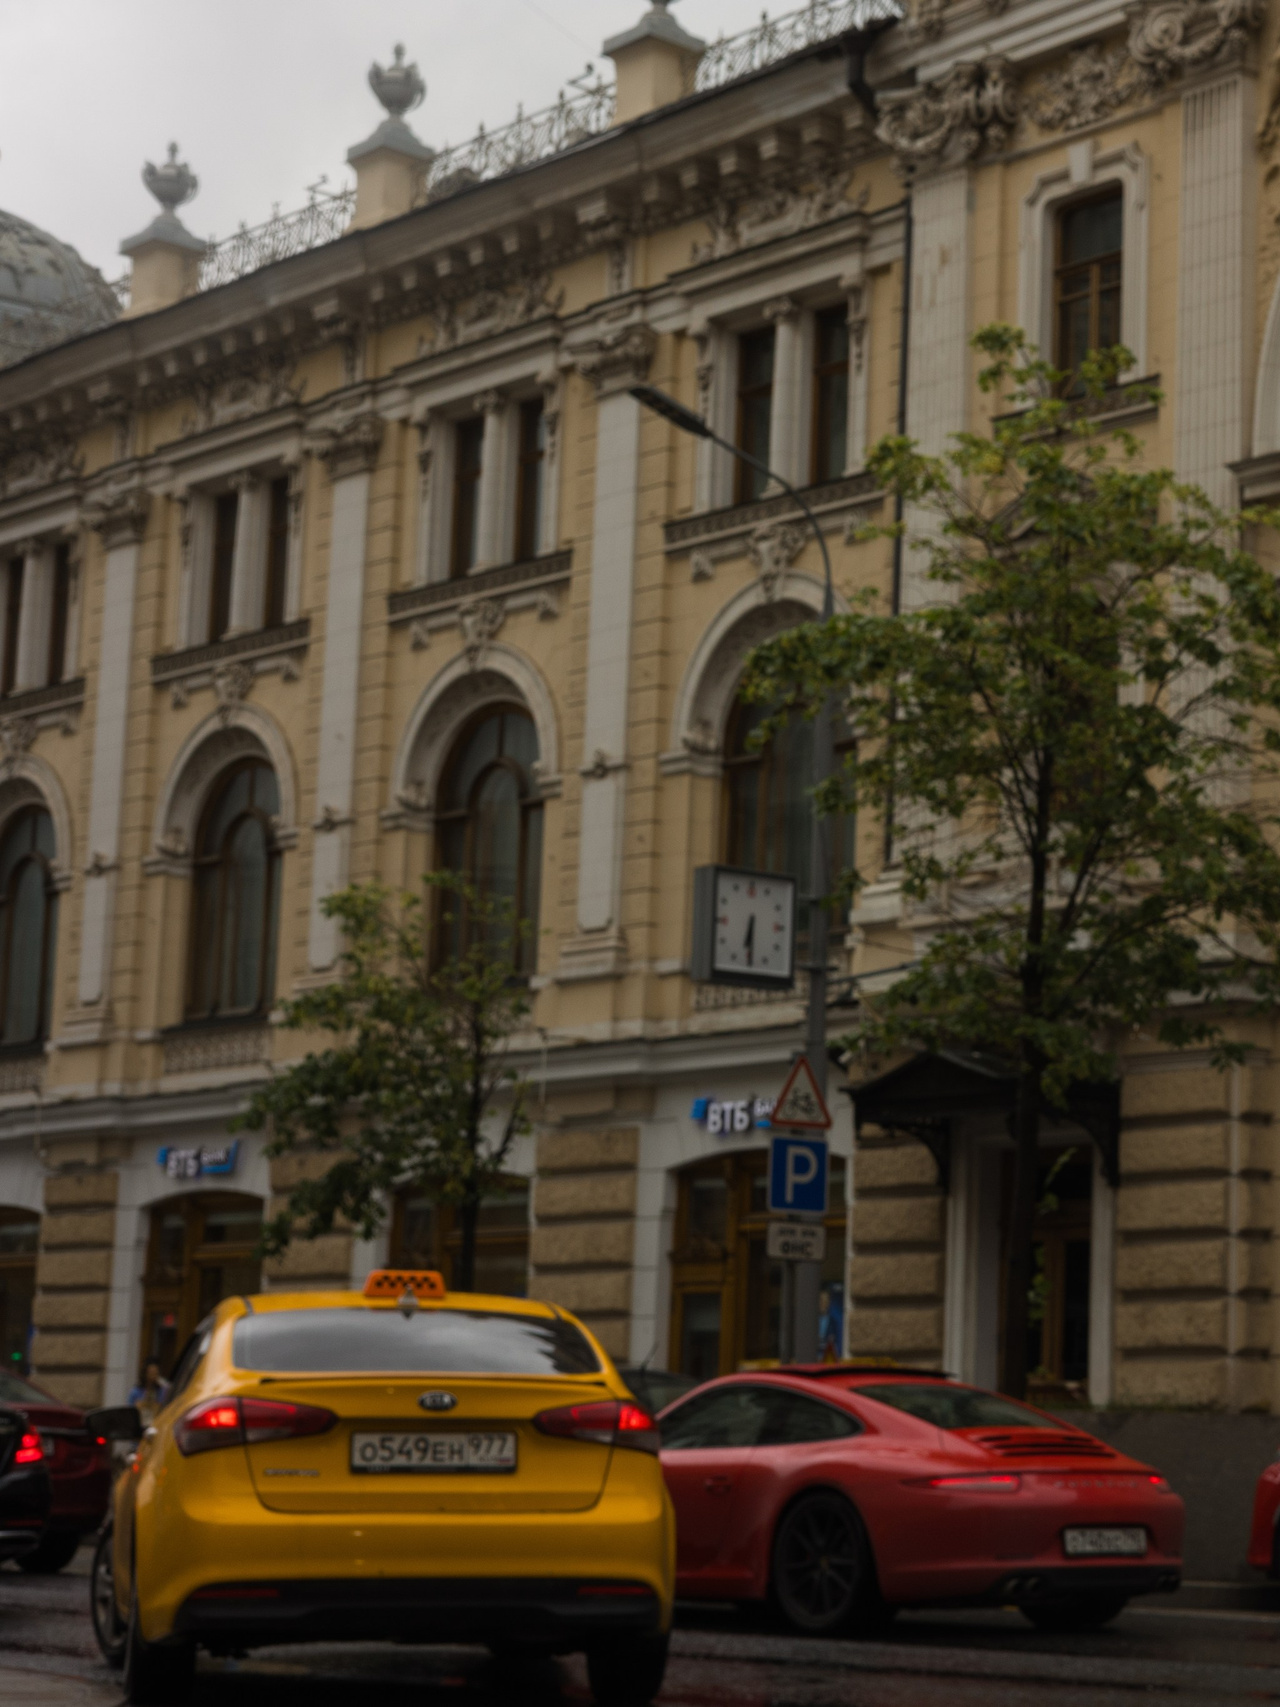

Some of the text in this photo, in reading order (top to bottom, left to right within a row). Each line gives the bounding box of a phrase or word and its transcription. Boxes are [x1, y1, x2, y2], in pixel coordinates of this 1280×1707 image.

[707, 1099, 750, 1134] ВТБ
[166, 1148, 198, 1179] ВТБ
[784, 1144, 818, 1204] P
[468, 1433, 508, 1455] 977
